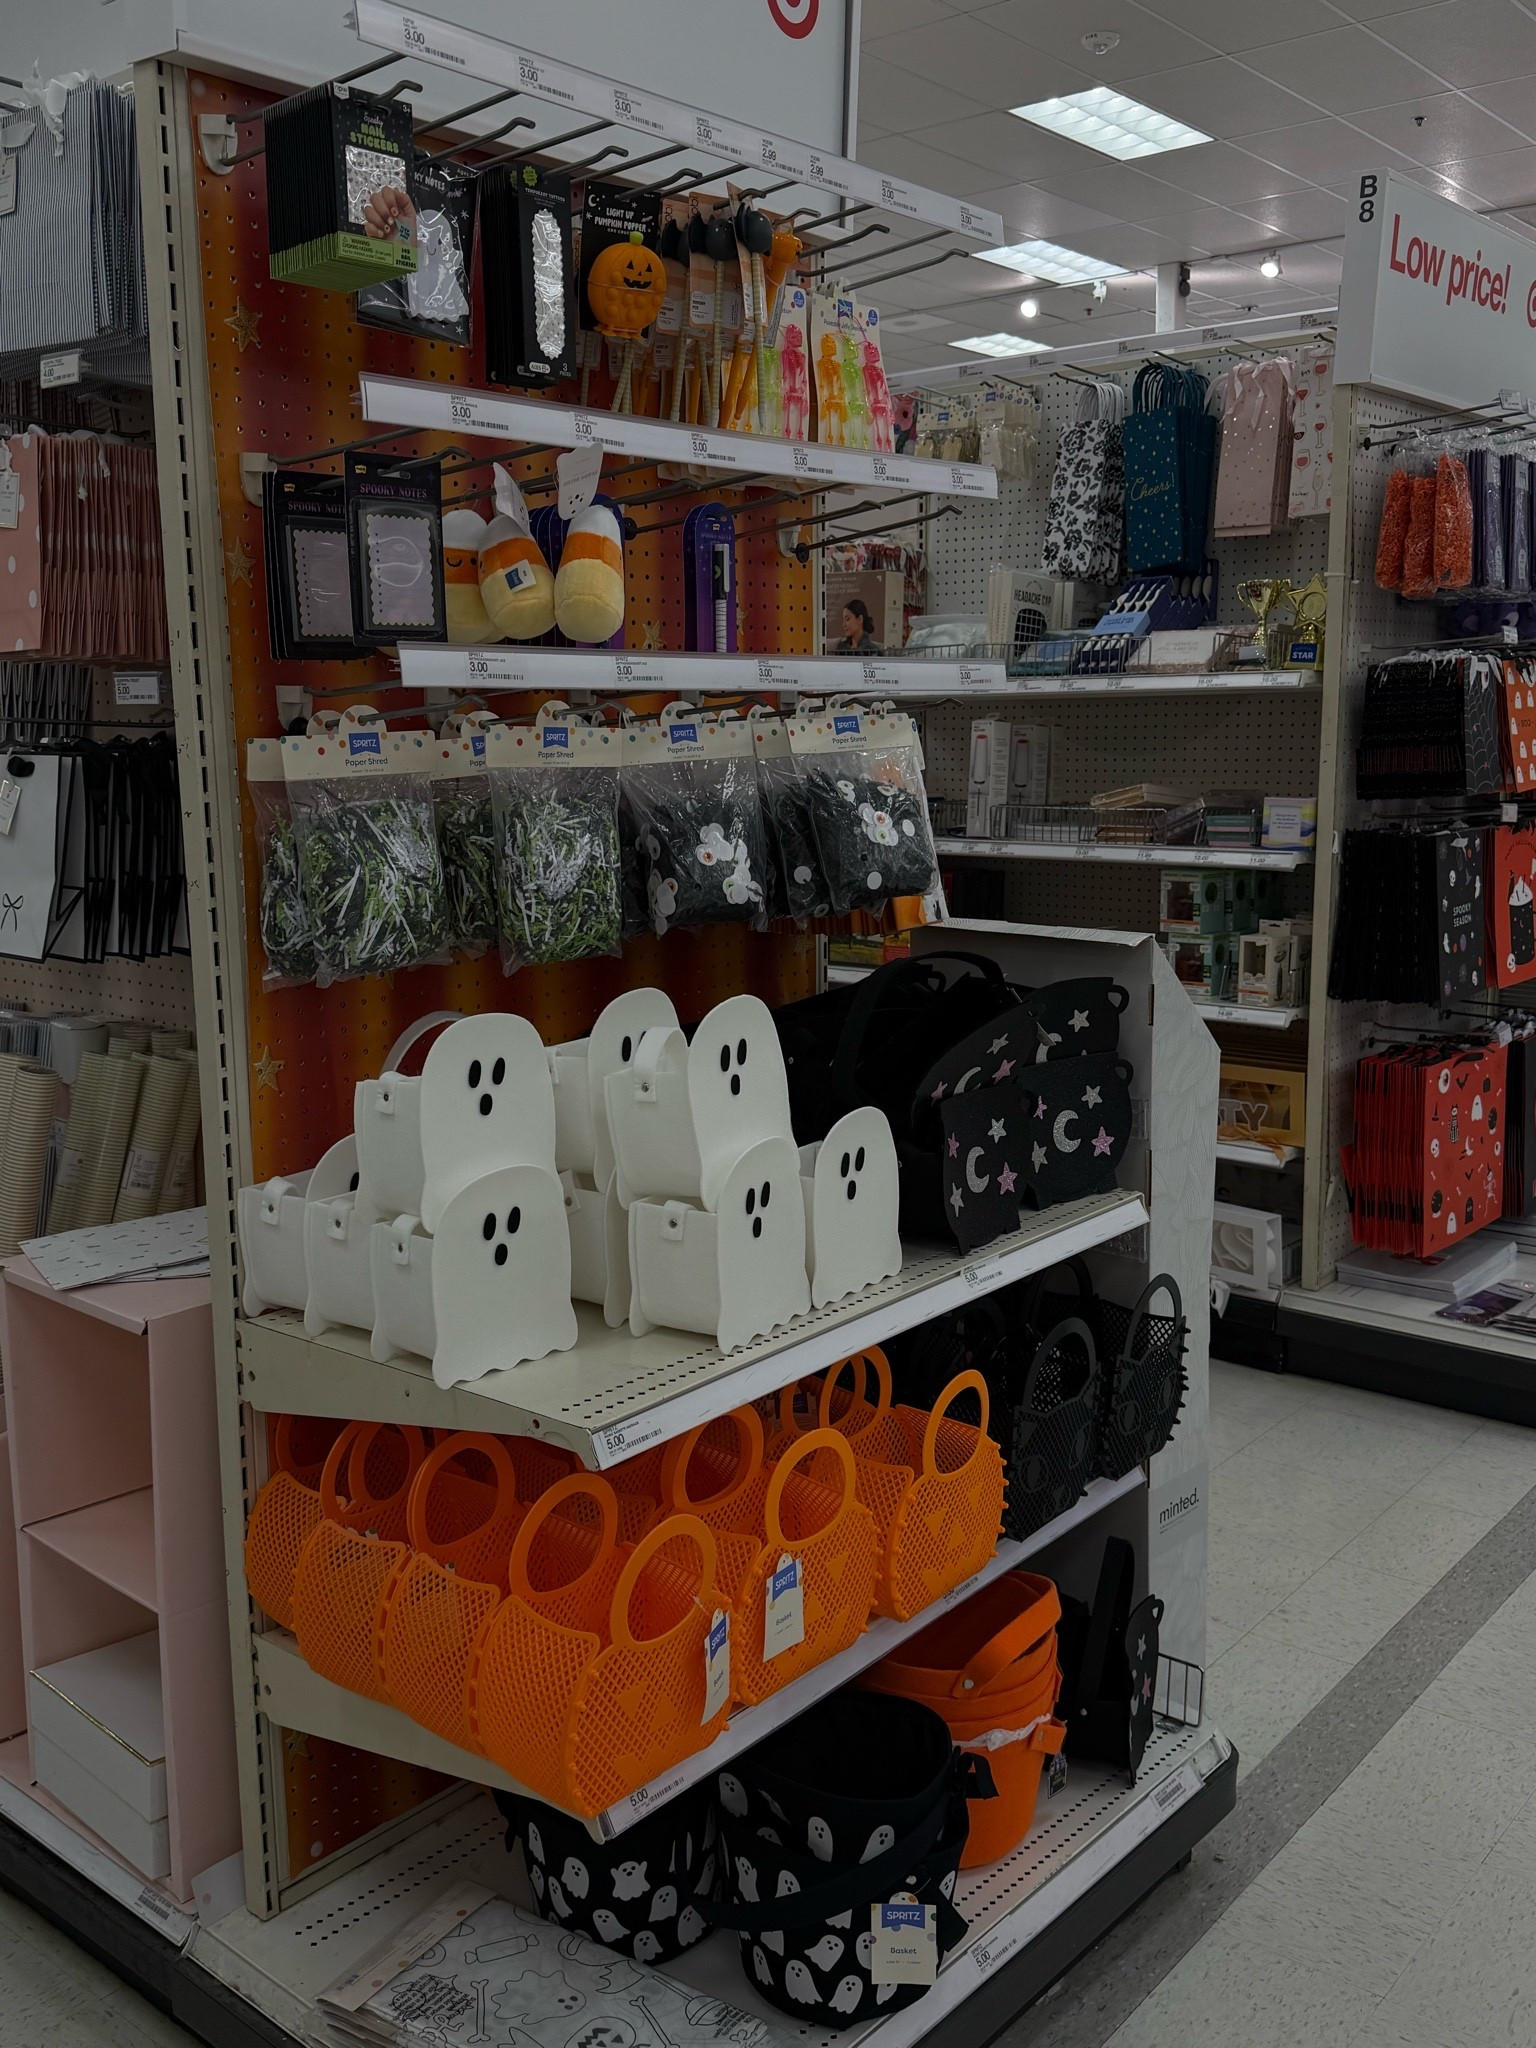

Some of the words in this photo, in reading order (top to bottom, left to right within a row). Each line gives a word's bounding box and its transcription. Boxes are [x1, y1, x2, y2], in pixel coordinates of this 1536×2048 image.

[405, 28, 424, 45] 3.00
[520, 66, 537, 82] 3.00
[615, 99, 631, 113] 3.00
[361, 123, 385, 138] NAIL
[697, 126, 712, 140] 3.00
[350, 131, 399, 154] STICKERS
[762, 148, 776, 161] 2.99
[810, 164, 823, 176] 2.99
[425, 175, 446, 191] NOTES
[1359, 174, 1377, 199] B
[881, 188, 894, 200] 3.00
[606, 207, 624, 219] LIGHT
[625, 210, 634, 220] UP
[1358, 200, 1374, 223] 8
[594, 216, 622, 229] PUMPKIN
[623, 221, 646, 233] POPPER
[961, 214, 972, 225] 3.00
[396, 260, 416, 268] STICKERS
[1389, 213, 1446, 287] Low
[1446, 249, 1511, 314] price!
[562, 362, 568, 372] 3
[452, 405, 471, 418] 3.00
[575, 422, 592, 435] 3.00
[692, 441, 707, 452] 3.00
[794, 456, 807, 466] 3.00
[874, 466, 886, 475] 3.00
[952, 476, 963, 484] 3.00
[360, 483, 395, 495] SPOOKY
[400, 487, 427, 499] NOTES
[1131, 472, 1174, 501] Cheers!
[287, 501, 321, 513] SPOOKY
[325, 504, 344, 514] NOT
[1014, 589, 1041, 605] HEADACHE
[1292, 651, 1314, 660] STAR
[470, 661, 488, 672] 3.00
[617, 666, 632, 676] 3.00
[759, 668, 772, 678] 3.00
[864, 670, 875, 679] 3.00
[960, 672, 971, 680] 3.00
[118, 686, 130, 695] 5.00
[837, 721, 857, 729] SPRITZ
[546, 733, 566, 741] SPRITZ
[673, 729, 694, 738] SPRITZ
[352, 738, 377, 748] SPRITZ
[832, 737, 849, 745] Paper
[667, 746, 686, 754] Paper
[686, 744, 704, 753] Shred
[345, 758, 366, 767] Paper
[367, 757, 388, 766] Shred
[538, 751, 556, 761] Paper
[556, 751, 574, 759] Shred
[1453, 902, 1471, 916] SPOOKY
[1453, 916, 1471, 928] SEASON
[965, 1271, 978, 1283] 5.00
[606, 1433, 625, 1450] 5.00
[1160, 1487, 1199, 1524] minted.
[775, 1570, 795, 1590] SPRITZ
[776, 1611, 792, 1626] Basket
[711, 1626, 725, 1650] SPRITZ
[630, 1788, 648, 1807] 5.00
[887, 1911, 920, 1920] SPRITZ
[890, 1947, 917, 1955] Basket
[975, 1950, 991, 1968] 5.00
